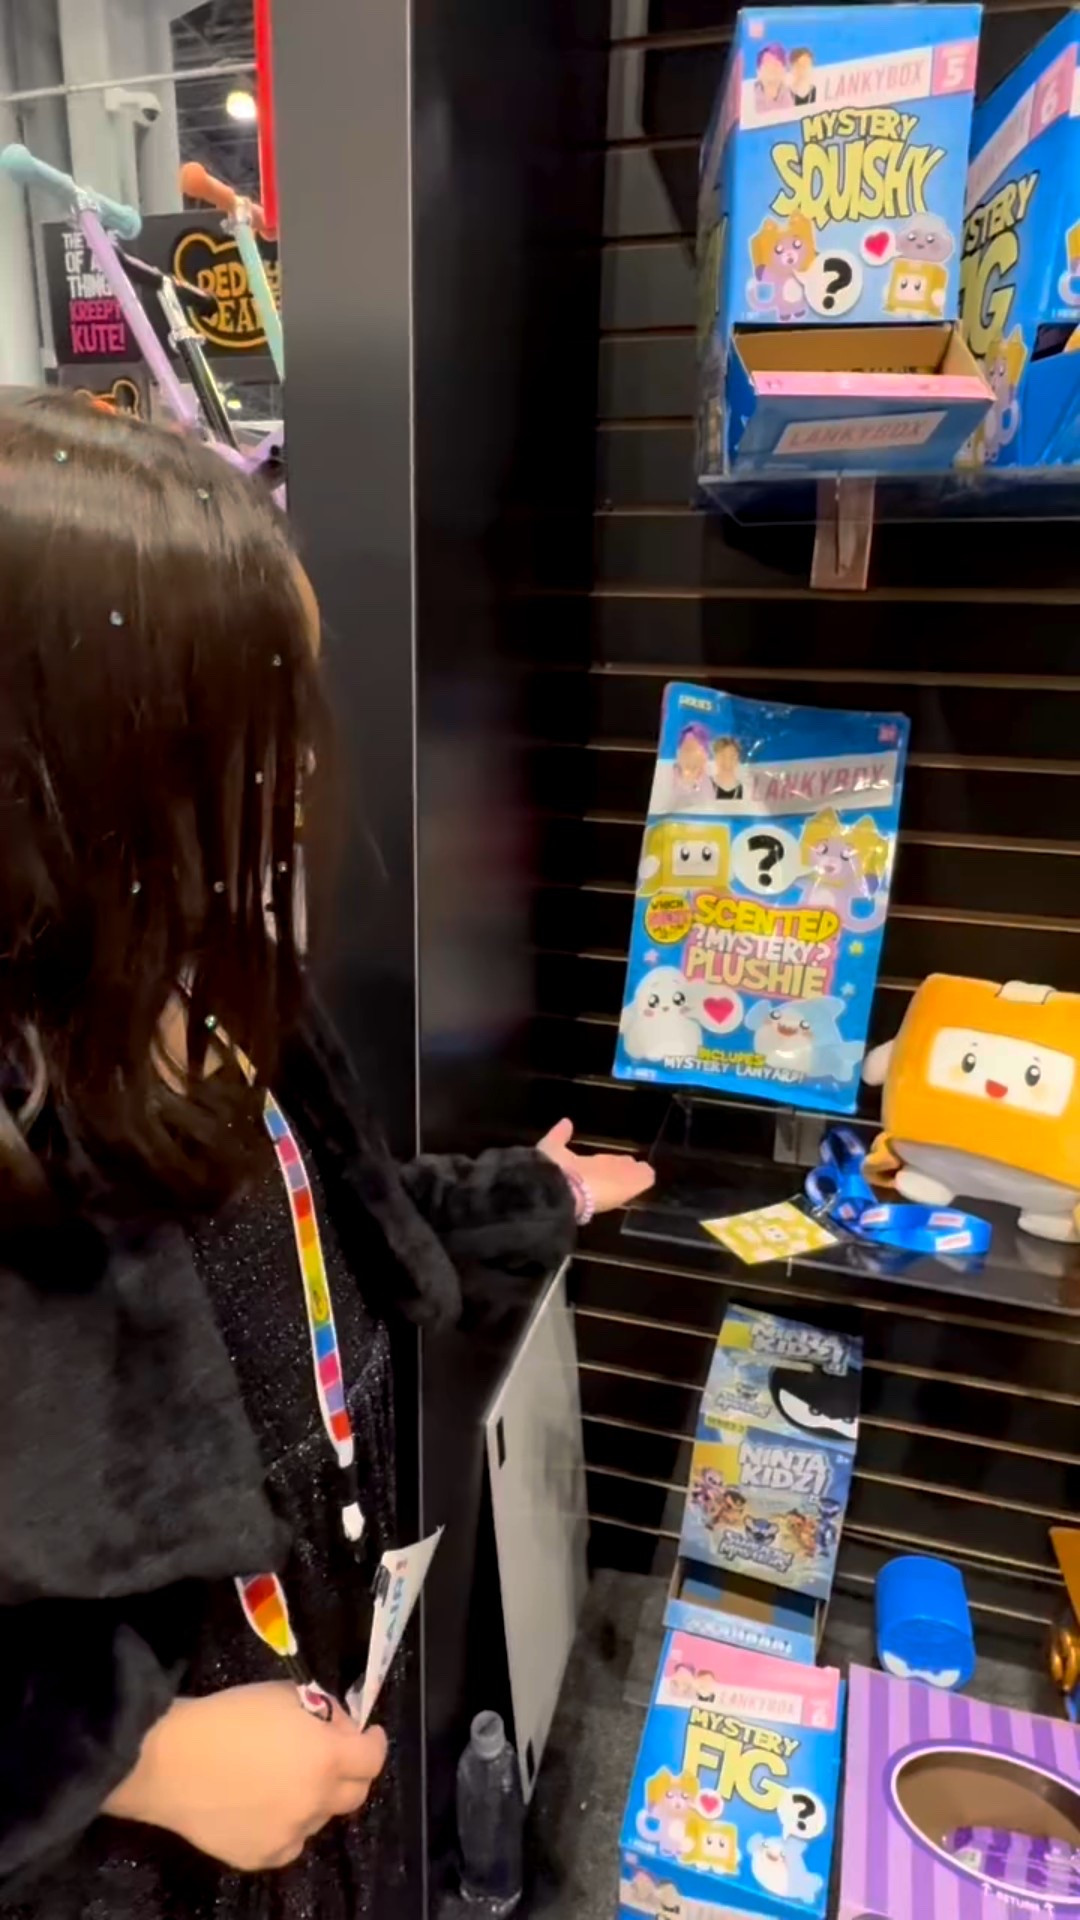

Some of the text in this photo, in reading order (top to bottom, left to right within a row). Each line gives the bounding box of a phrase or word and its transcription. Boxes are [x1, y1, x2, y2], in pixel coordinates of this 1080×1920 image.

[823, 57, 972, 101] LANKYBOX 5
[801, 107, 919, 142] MYSTERY
[769, 140, 948, 231] SQUISHY
[962, 170, 1041, 258] STERY
[65, 250, 84, 273] OF
[71, 323, 126, 353] KUTE!
[788, 420, 924, 449] LANKYBOX
[751, 763, 885, 800] LANKYBOX
[695, 895, 840, 942] SCENTED
[692, 923, 832, 967] ?MYSTERY?
[685, 946, 828, 1000] PLUSHIE
[663, 1055, 729, 1074] MYSTERY
[697, 1046, 767, 1067] INCLUDES
[738, 1443, 828, 1474] NINJA
[690, 1706, 800, 1759] MYSTERY
[682, 1723, 789, 1812] FIG
